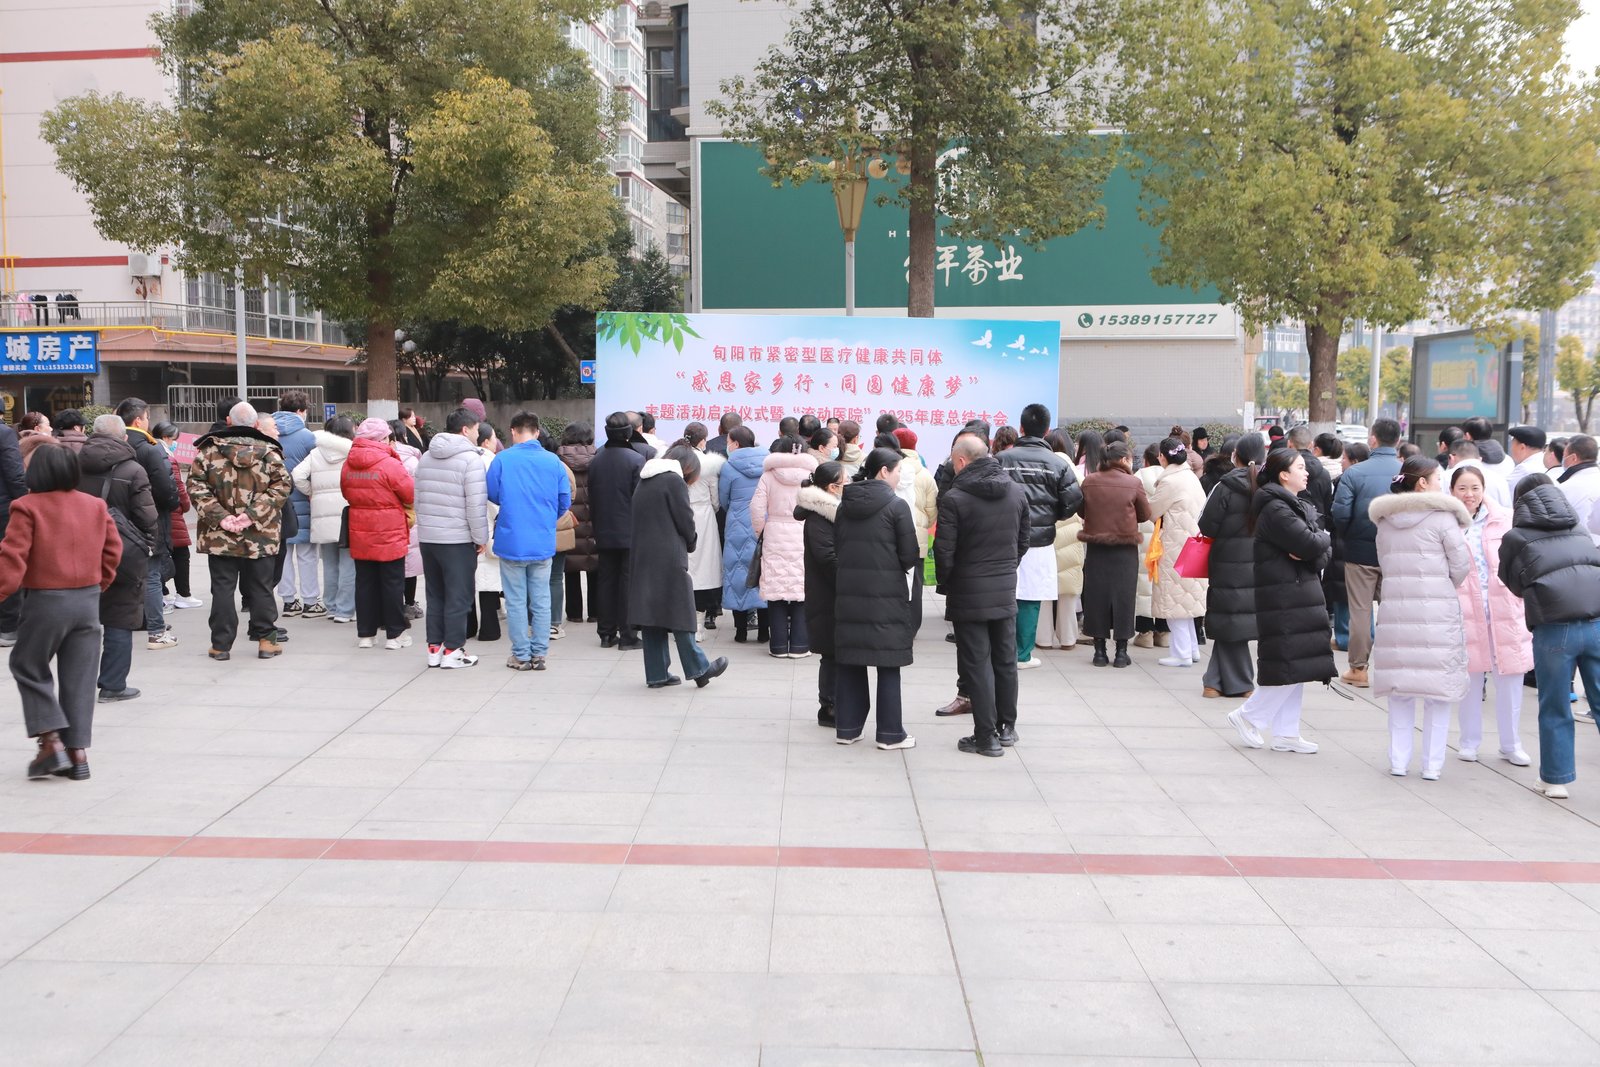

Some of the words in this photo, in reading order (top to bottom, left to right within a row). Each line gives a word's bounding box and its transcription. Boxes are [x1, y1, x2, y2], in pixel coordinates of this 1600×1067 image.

[904, 244, 1024, 288] 平茶业
[1098, 313, 1218, 326] 15389157727
[5, 334, 93, 361] 城房产
[713, 344, 943, 365] 旬阳市紧密型医疗健康共同体
